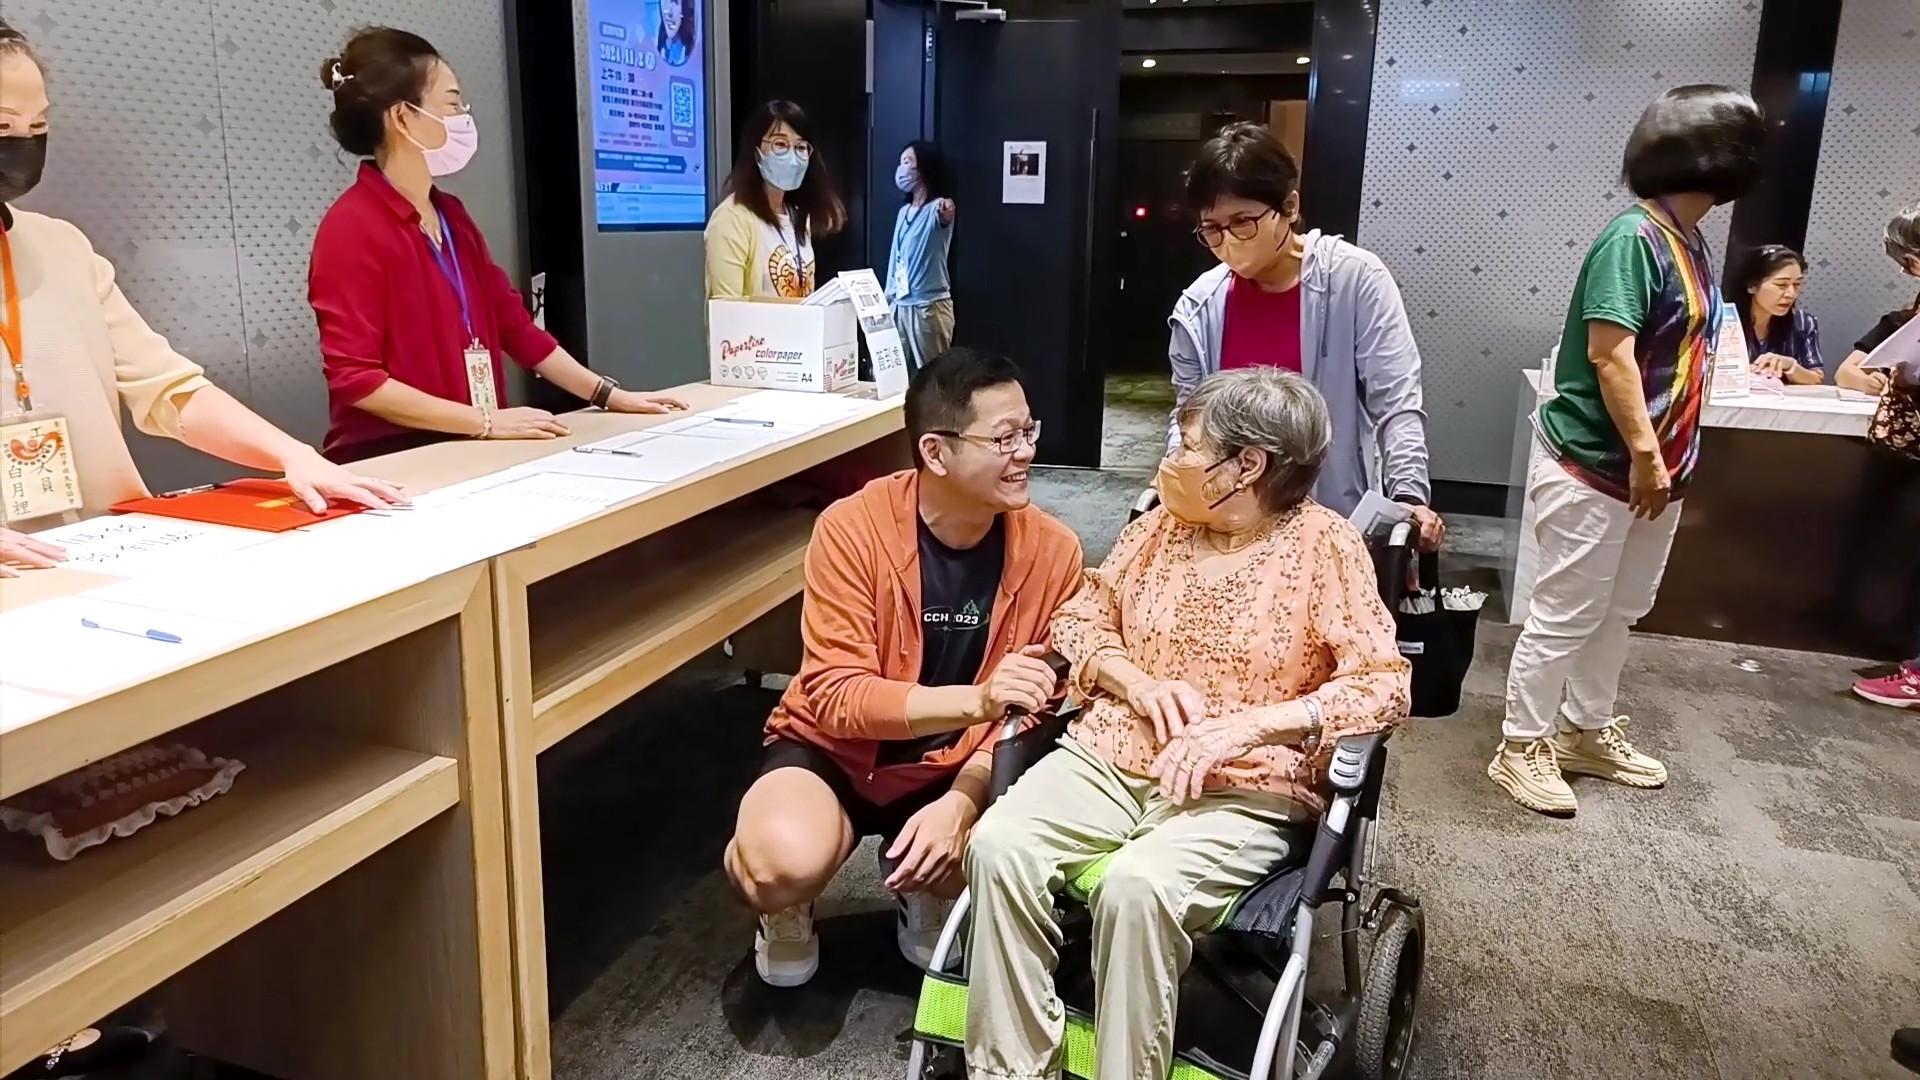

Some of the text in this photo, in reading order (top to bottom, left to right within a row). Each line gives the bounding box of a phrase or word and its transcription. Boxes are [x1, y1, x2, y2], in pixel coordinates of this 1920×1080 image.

[801, 373, 813, 383] A4
[923, 613, 979, 625] CCH 023
